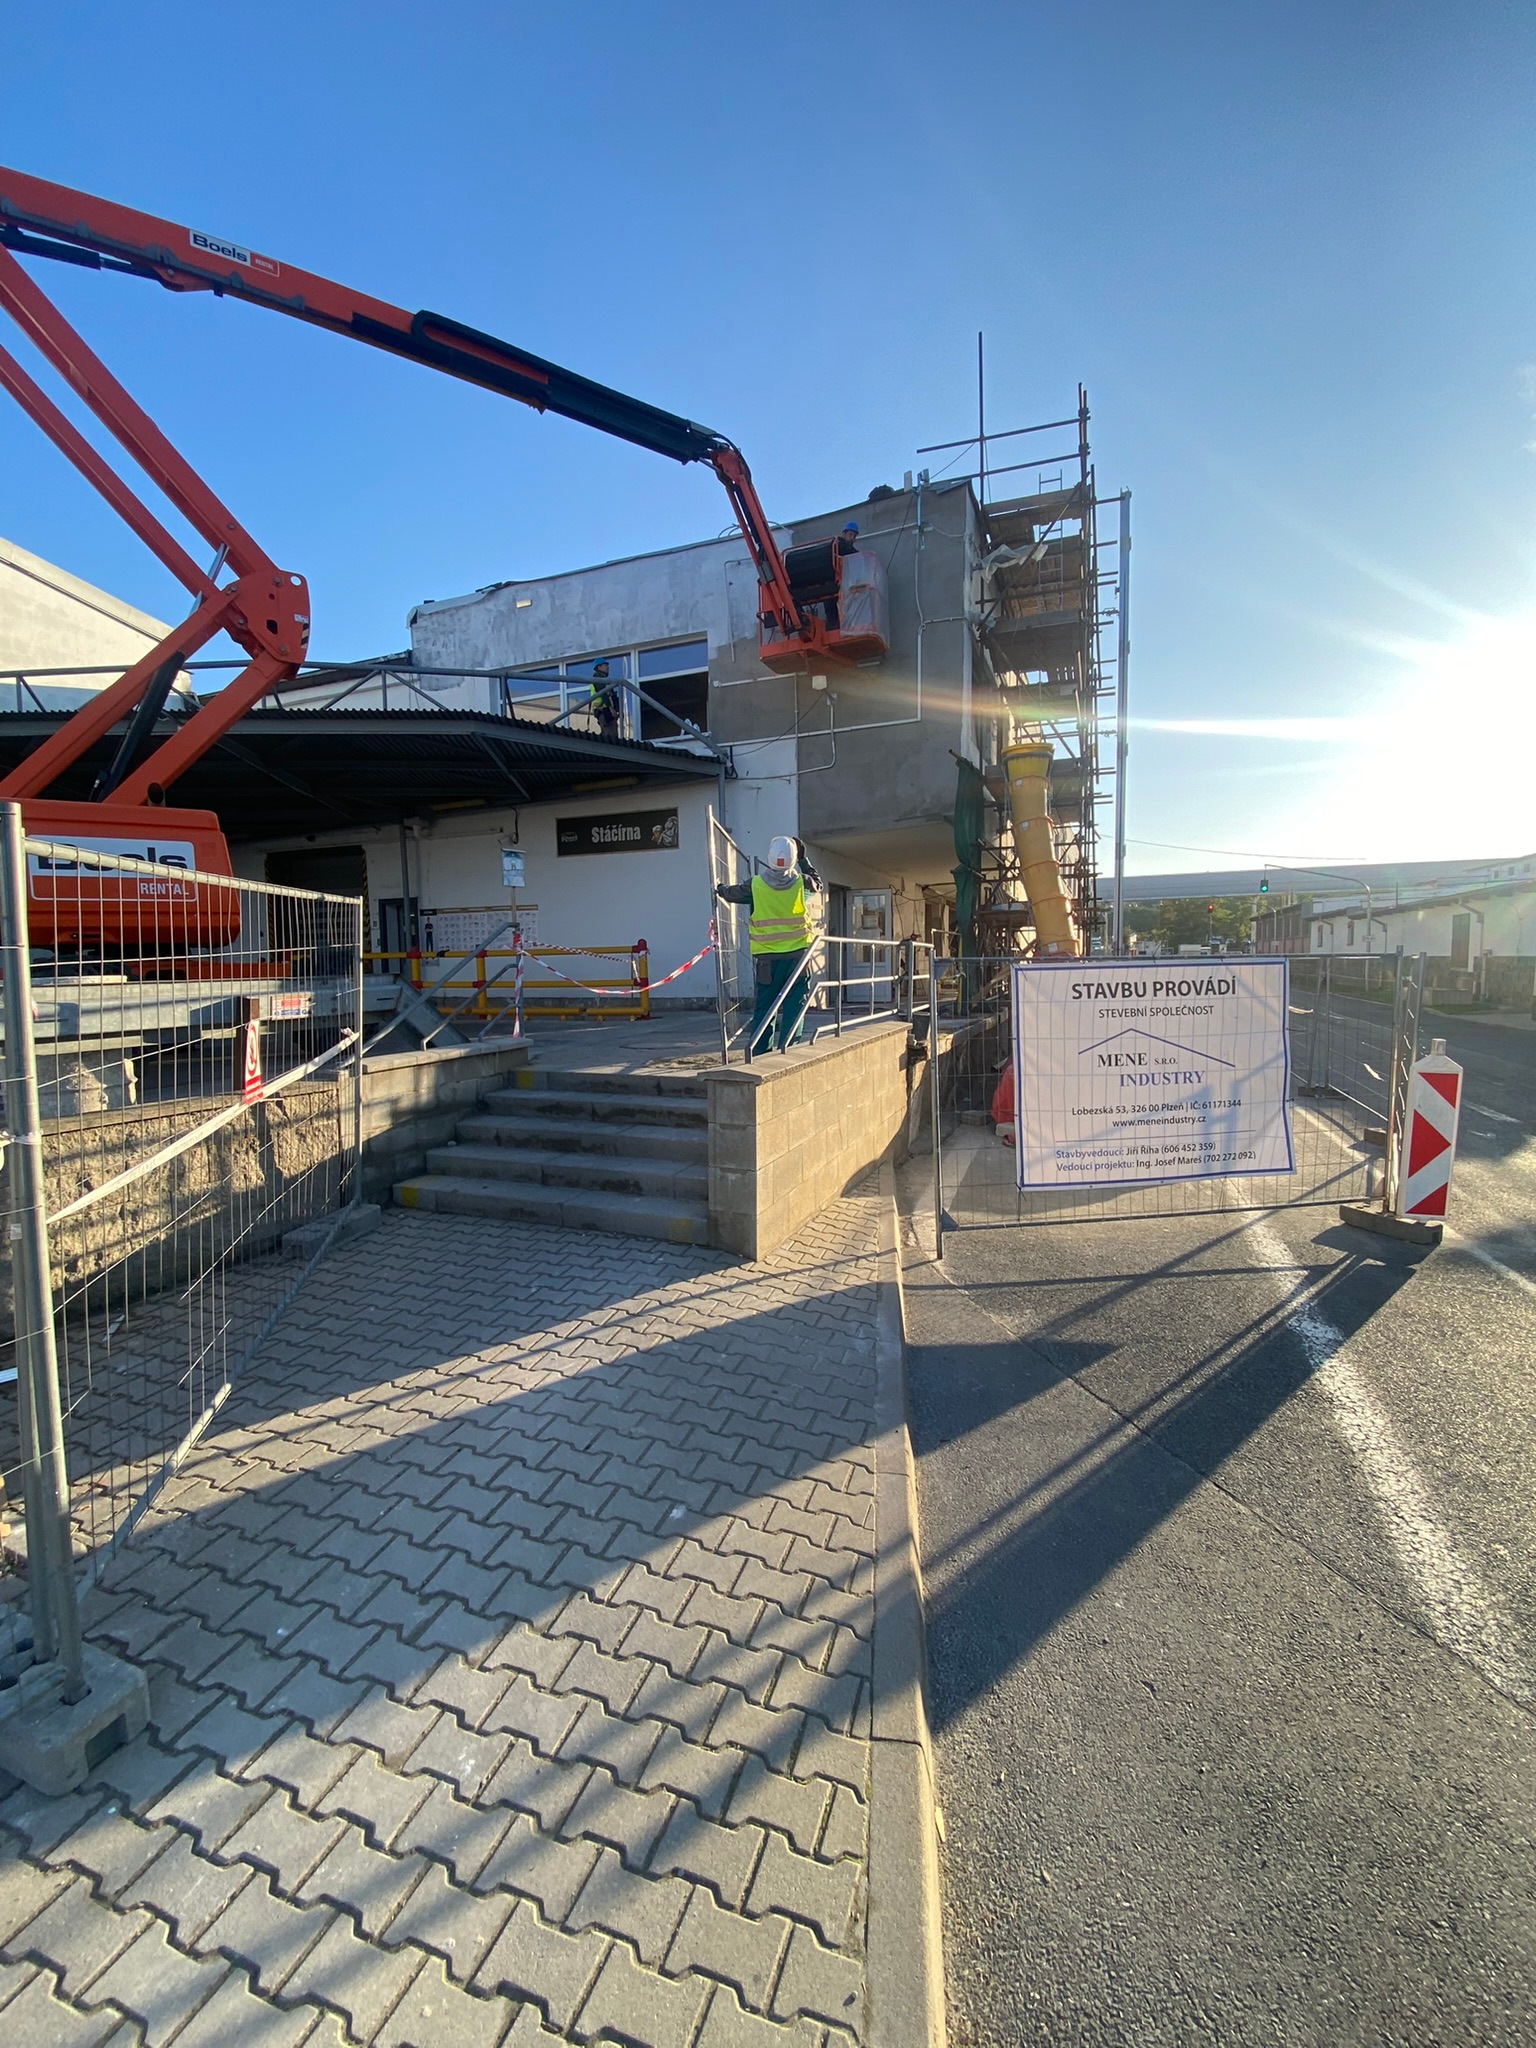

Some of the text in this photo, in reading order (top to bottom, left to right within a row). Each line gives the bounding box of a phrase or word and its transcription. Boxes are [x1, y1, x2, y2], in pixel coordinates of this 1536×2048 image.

[193, 233, 247, 262] Boels
[591, 824, 641, 843] Stáčírna
[1071, 975, 1236, 1000] STAVBU PROVÁDÍ
[1098, 1004, 1214, 1019] STEVEBNÍ SPOLEČNOST
[1097, 1052, 1178, 1068] MENE S.R.O.
[1120, 1071, 1204, 1087] INDUSTRY
[1071, 1106, 1114, 1116] Lobezská
[1115, 1105, 1129, 1115] 53,
[1130, 1104, 1147, 1113] 326
[1148, 1103, 1160, 1112] 00
[1161, 1102, 1184, 1112] Plzeň
[1201, 1099, 1242, 1110] 61171344
[1112, 1116, 1206, 1127] www.meneindustry.cz
[1056, 1149, 1124, 1159] Stavbyvedoucí:
[1161, 1143, 1180, 1154] (606
[1181, 1143, 1198, 1152] 452
[1198, 1142, 1216, 1152] 359)
[1056, 1161, 1093, 1171] Vedoucí
[1094, 1159, 1135, 1172] projektu:
[1136, 1158, 1153, 1169] Ing.
[1154, 1156, 1176, 1167] Josef
[1203, 1152, 1221, 1163] (702
[1221, 1152, 1237, 1161] 272
[1236, 1149, 1256, 1160] 092)
